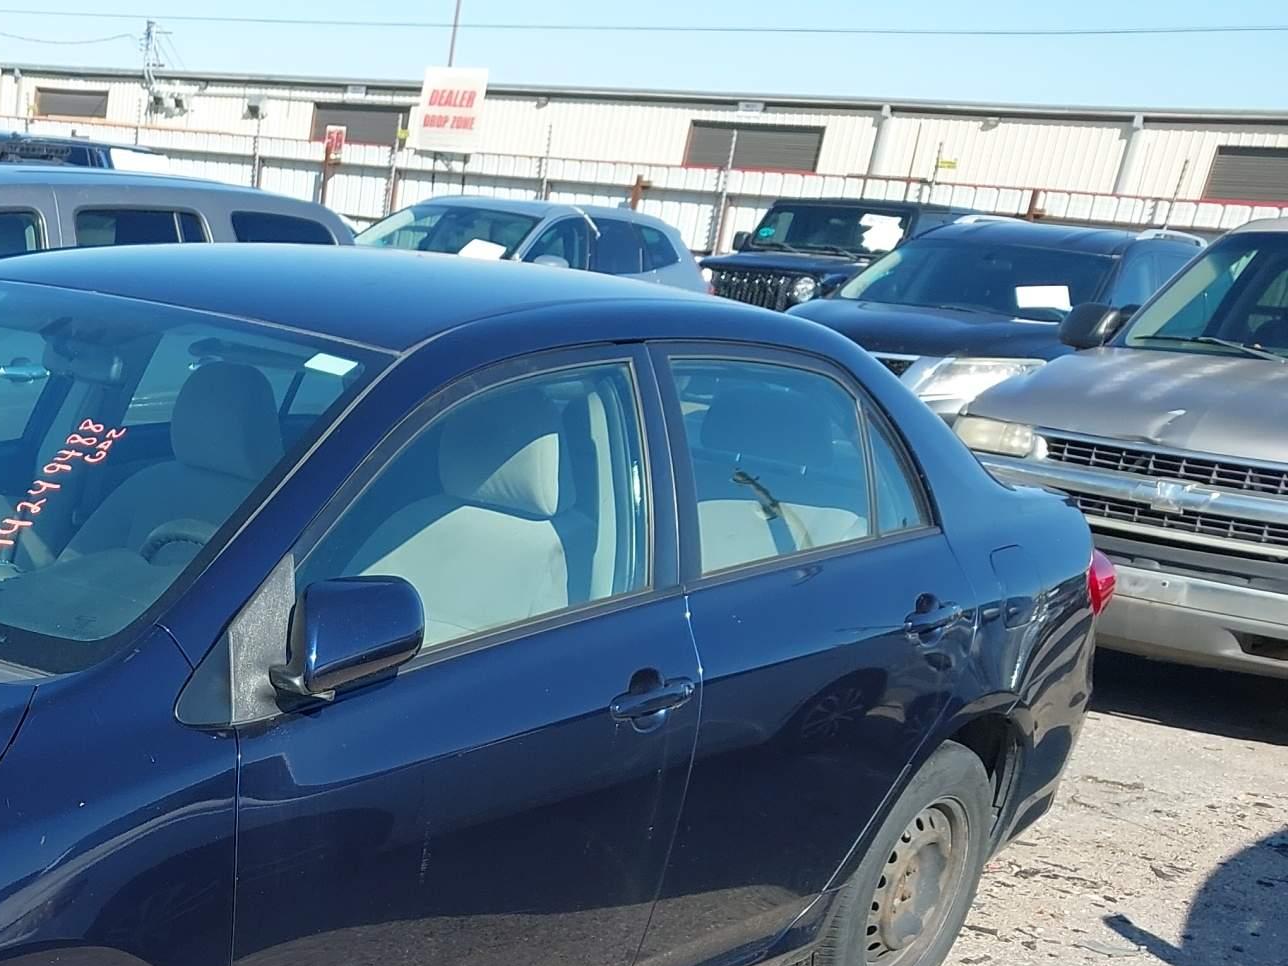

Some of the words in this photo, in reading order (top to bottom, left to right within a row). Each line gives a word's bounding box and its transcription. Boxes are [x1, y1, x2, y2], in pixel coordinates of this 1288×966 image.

[428, 89, 477, 108] DEALER
[423, 114, 449, 128] DROP
[450, 115, 475, 130] ZONE
